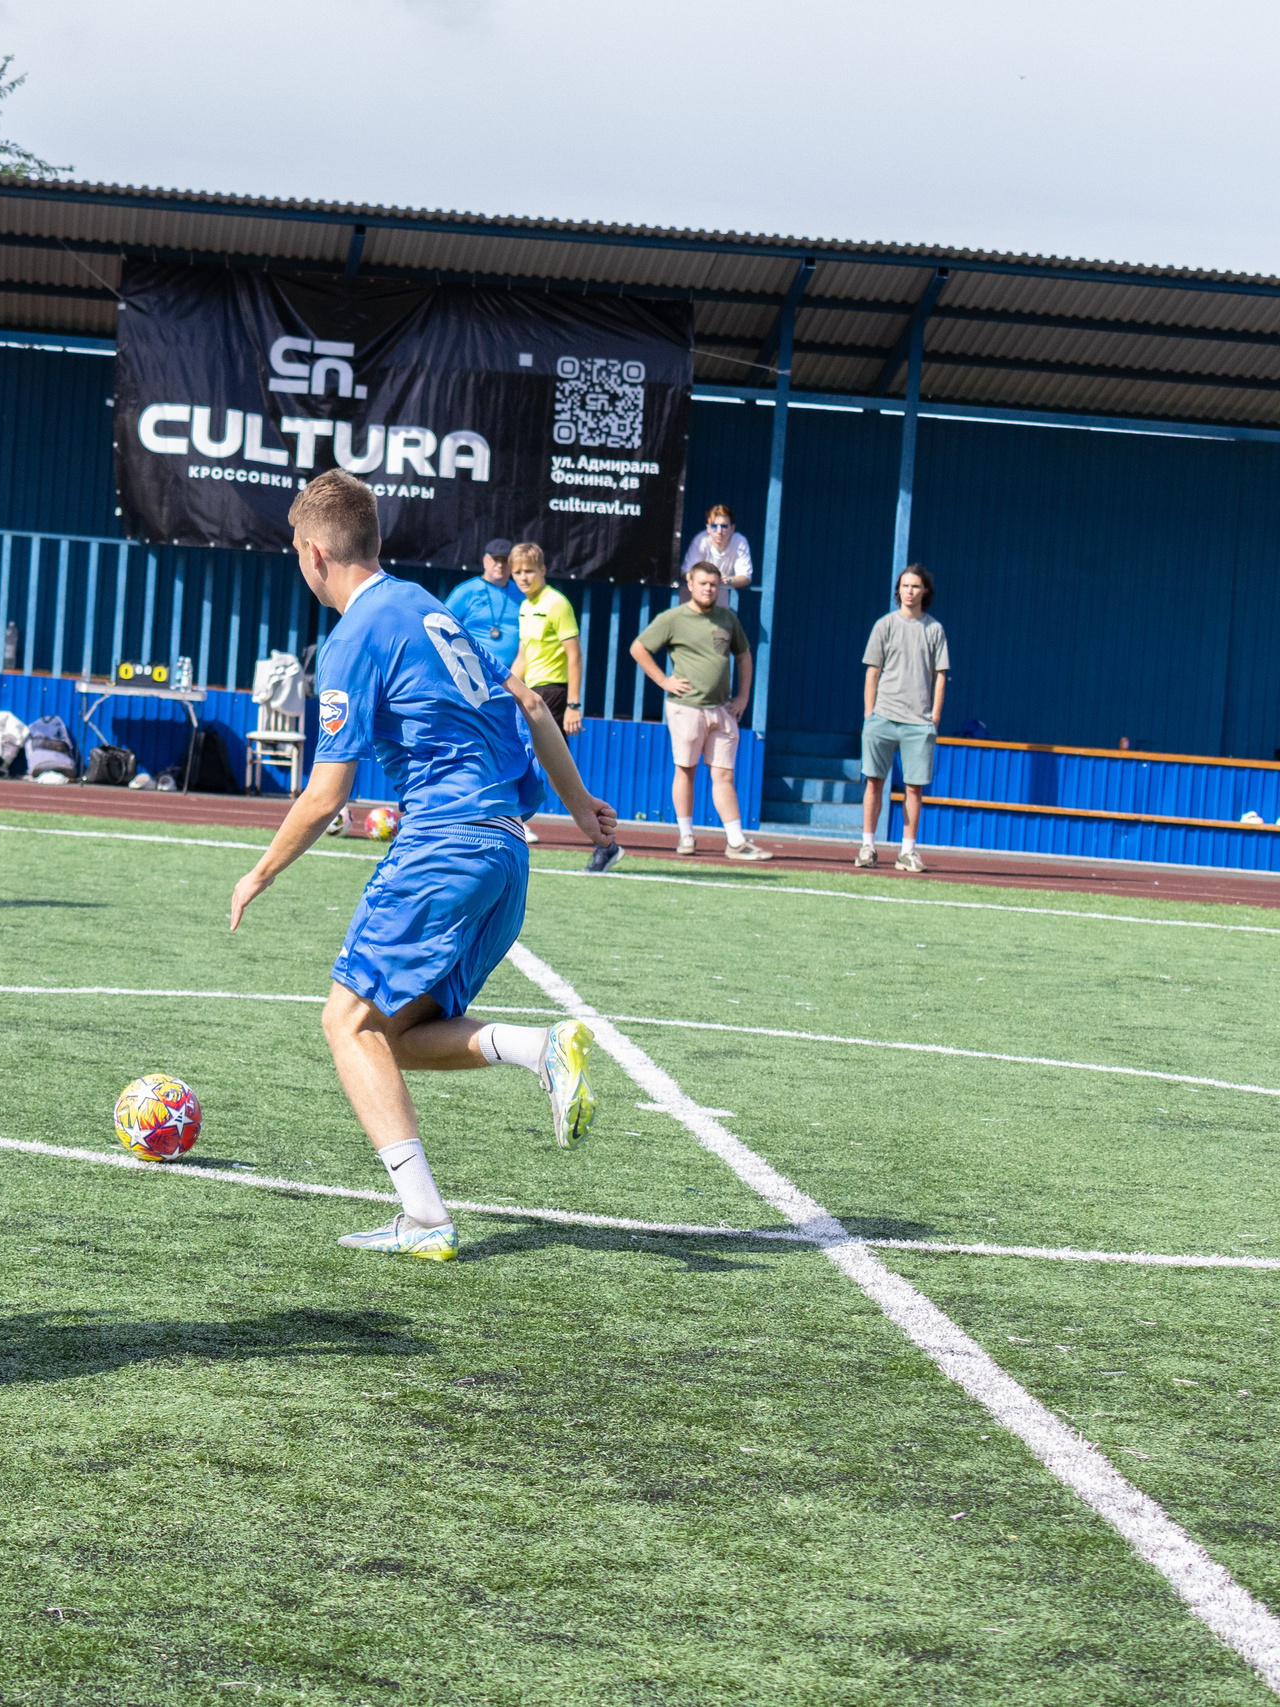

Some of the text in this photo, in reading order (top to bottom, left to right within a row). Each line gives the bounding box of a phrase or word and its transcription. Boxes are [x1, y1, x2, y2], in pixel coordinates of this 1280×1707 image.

[138, 403, 491, 482] CULTURA
[551, 455, 660, 475] ул. Адмирала
[188, 465, 293, 488] КРОССОВКИ
[551, 469, 617, 489] Фокина,
[549, 497, 641, 516] culturavl.ru
[423, 612, 490, 709] 6
